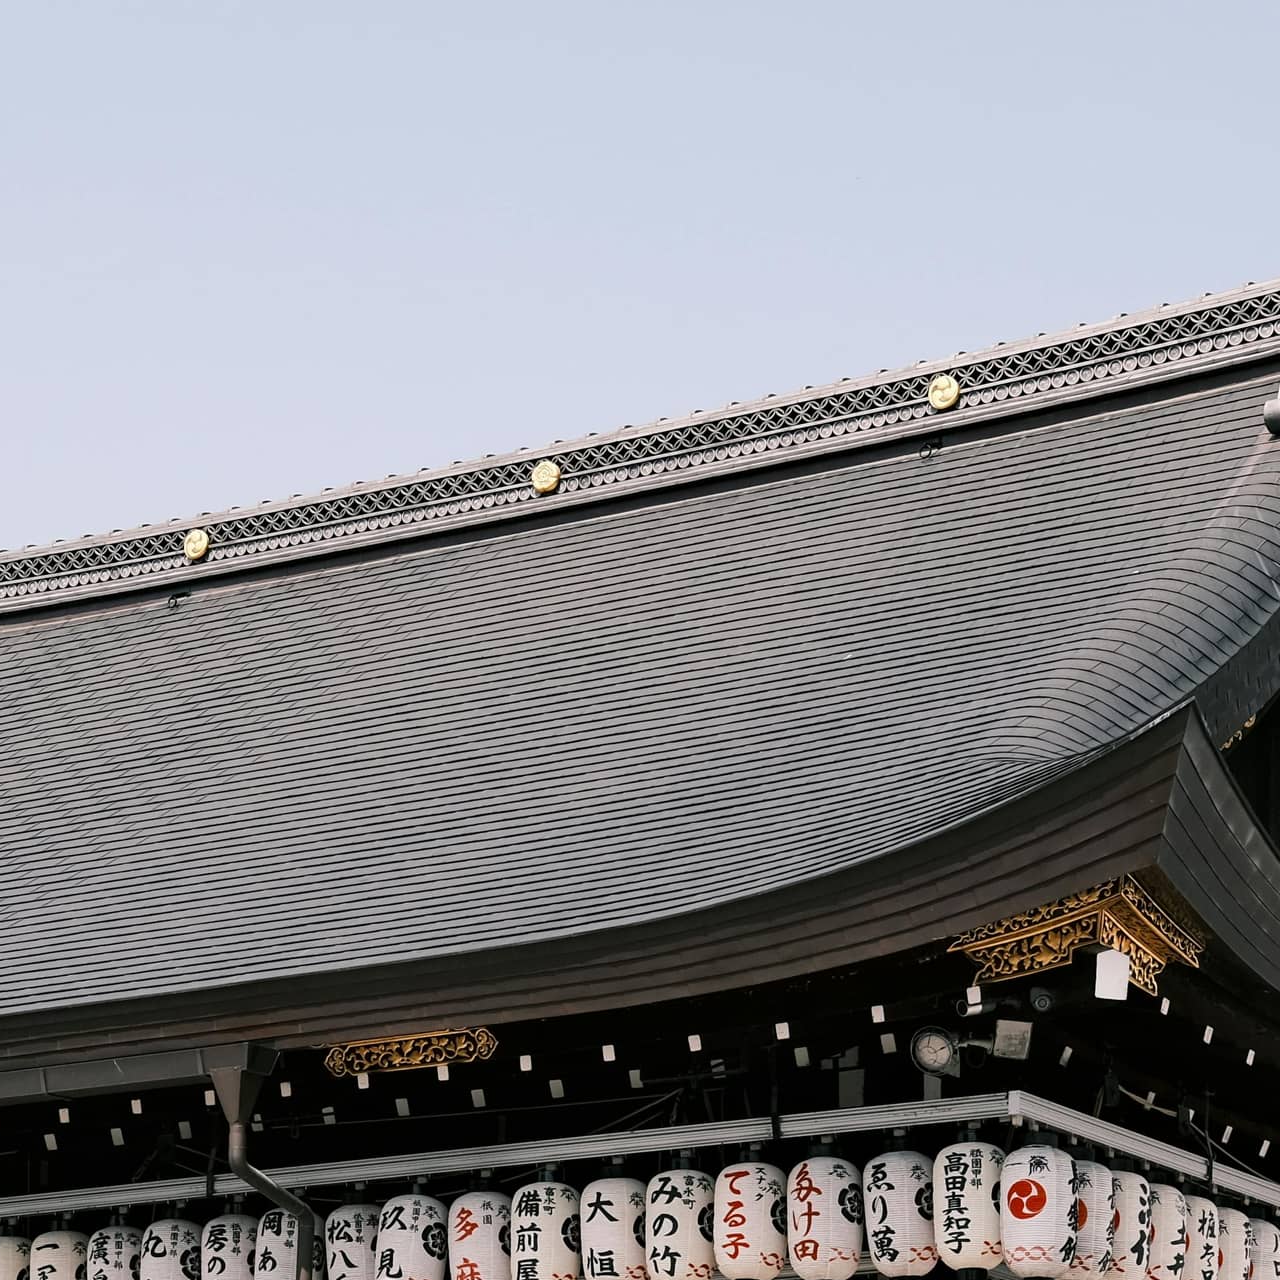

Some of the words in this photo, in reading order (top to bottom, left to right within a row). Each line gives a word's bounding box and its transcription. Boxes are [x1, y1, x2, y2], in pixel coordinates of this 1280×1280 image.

[755, 1168, 767, 1202] スナック
[942, 1152, 971, 1255] 高田真知子
[970, 1148, 984, 1190] 祇園甲部
[586, 1192, 620, 1278] 大恒
[650, 1176, 681, 1278] みの竹
[721, 1170, 750, 1259] てる子
